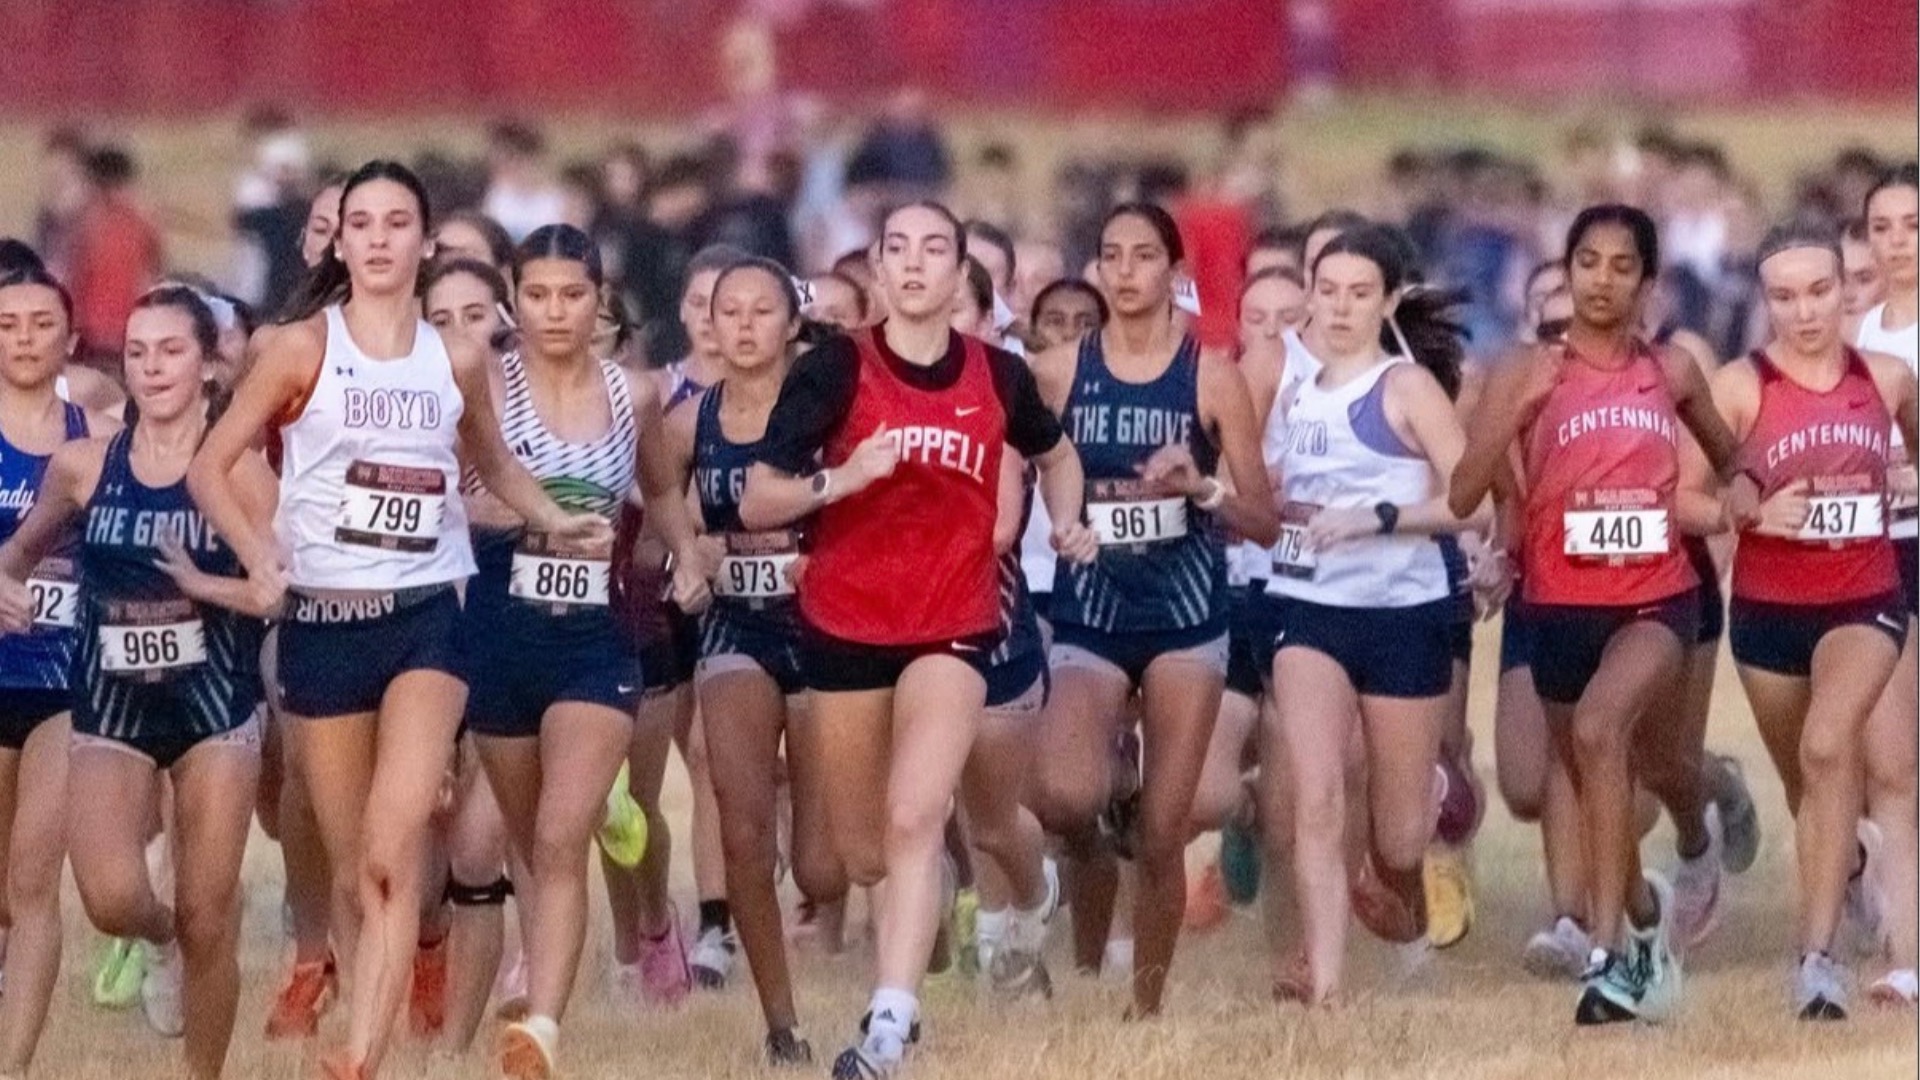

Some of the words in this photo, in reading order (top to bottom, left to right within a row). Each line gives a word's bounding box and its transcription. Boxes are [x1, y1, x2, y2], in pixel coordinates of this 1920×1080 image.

[344, 388, 441, 430] BOYD
[1072, 405, 1110, 444] THE
[1116, 406, 1192, 447] GROVE
[884, 425, 985, 485] OPPELL
[0, 478, 35, 519] ady
[368, 494, 421, 533] 799
[1111, 506, 1161, 540] 961
[1589, 516, 1643, 549] 440
[1810, 501, 1858, 534] 437
[536, 562, 589, 599] 866
[729, 560, 778, 594] 973
[297, 592, 394, 623] ARMOUR
[123, 630, 179, 666] 966
